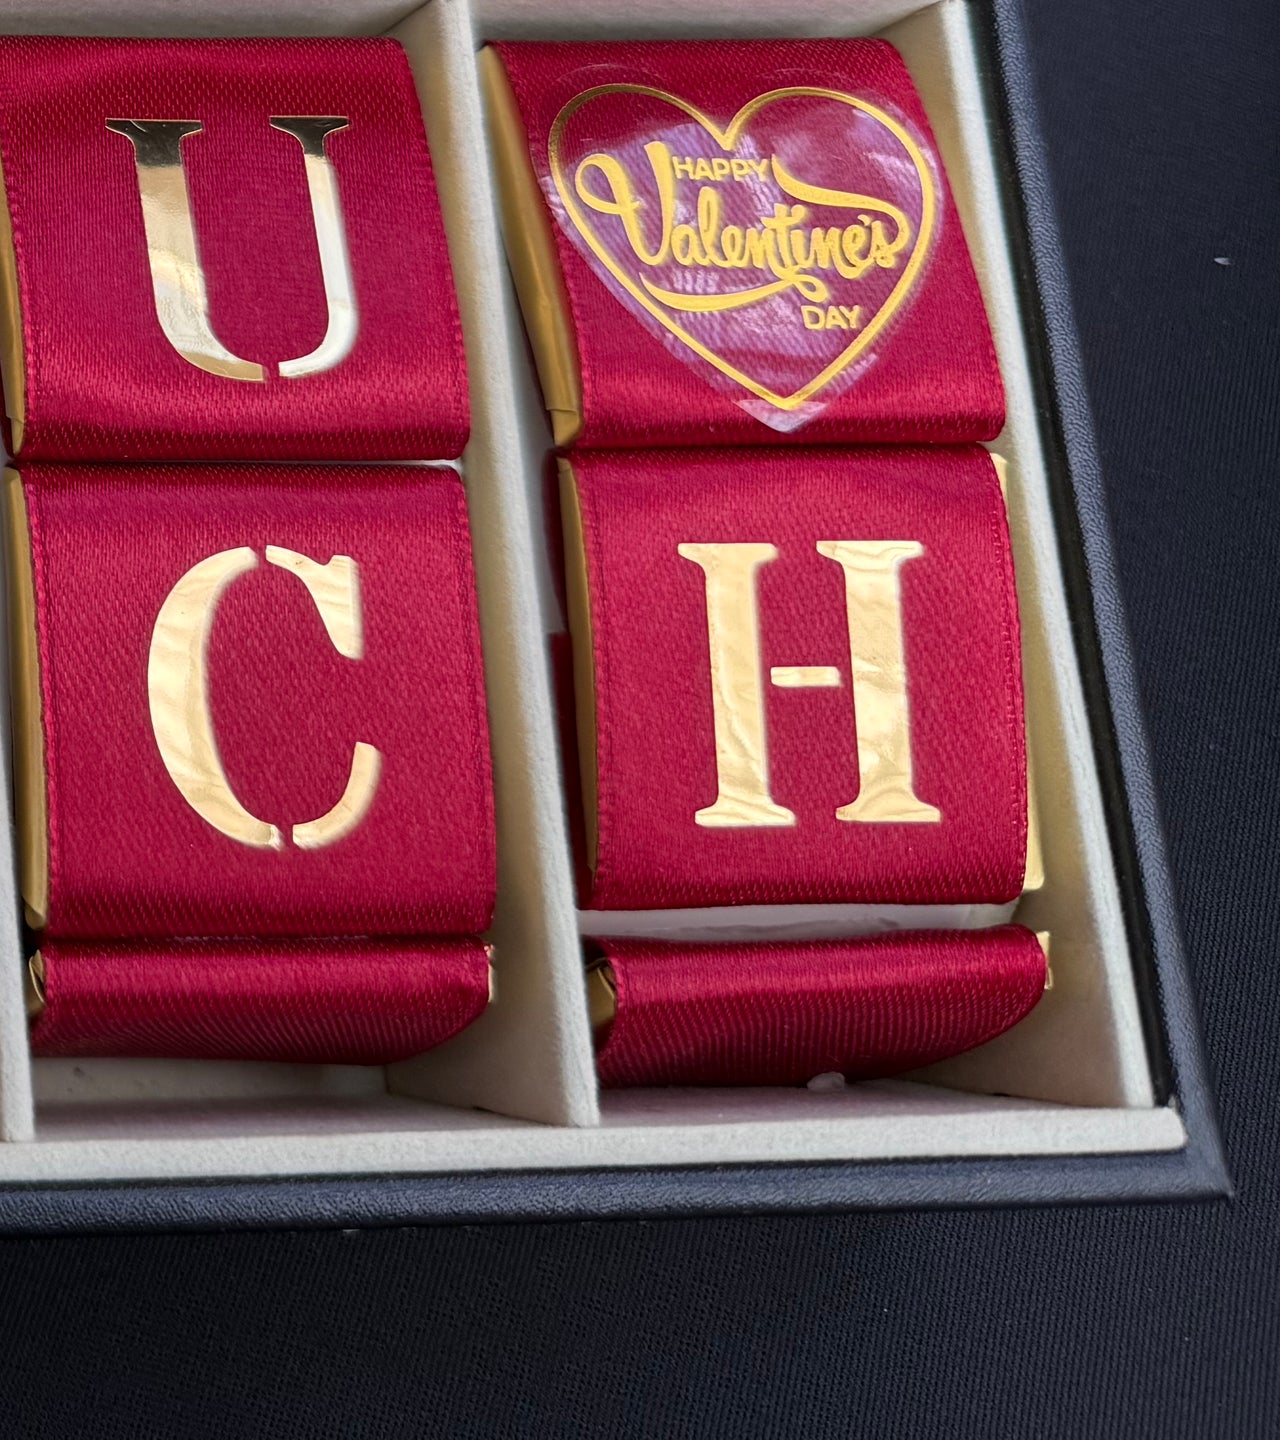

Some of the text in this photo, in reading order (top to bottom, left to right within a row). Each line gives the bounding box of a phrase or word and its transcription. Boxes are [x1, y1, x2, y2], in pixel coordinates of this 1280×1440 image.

[672, 156, 772, 182] HAPPY
[575, 141, 912, 303] Valentine's
[800, 304, 861, 331] DAY
